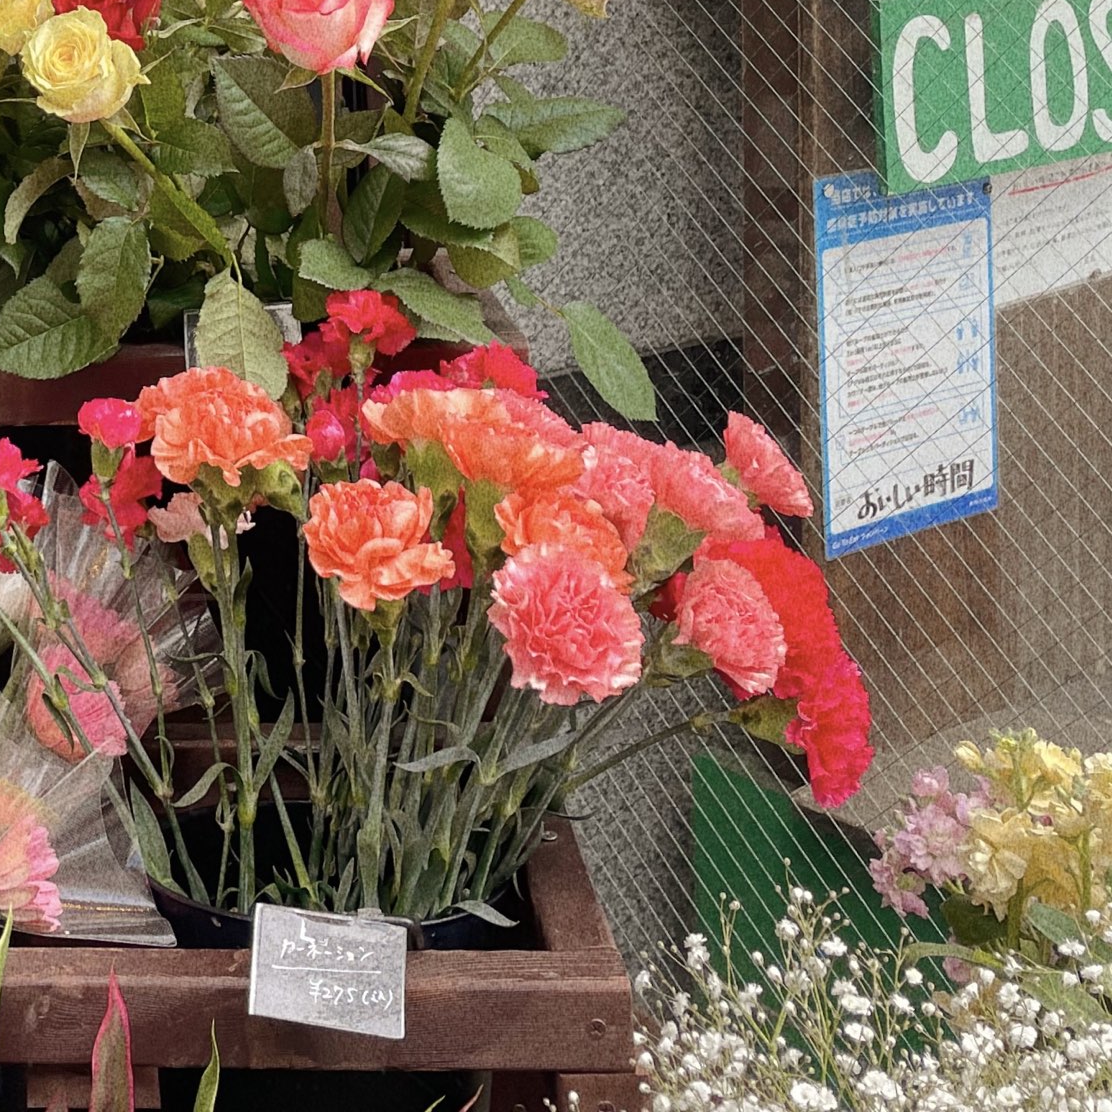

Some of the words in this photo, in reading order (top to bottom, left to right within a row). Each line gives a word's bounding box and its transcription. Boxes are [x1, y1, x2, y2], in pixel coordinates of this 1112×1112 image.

[857, 458, 975, 520] おいしい時間
